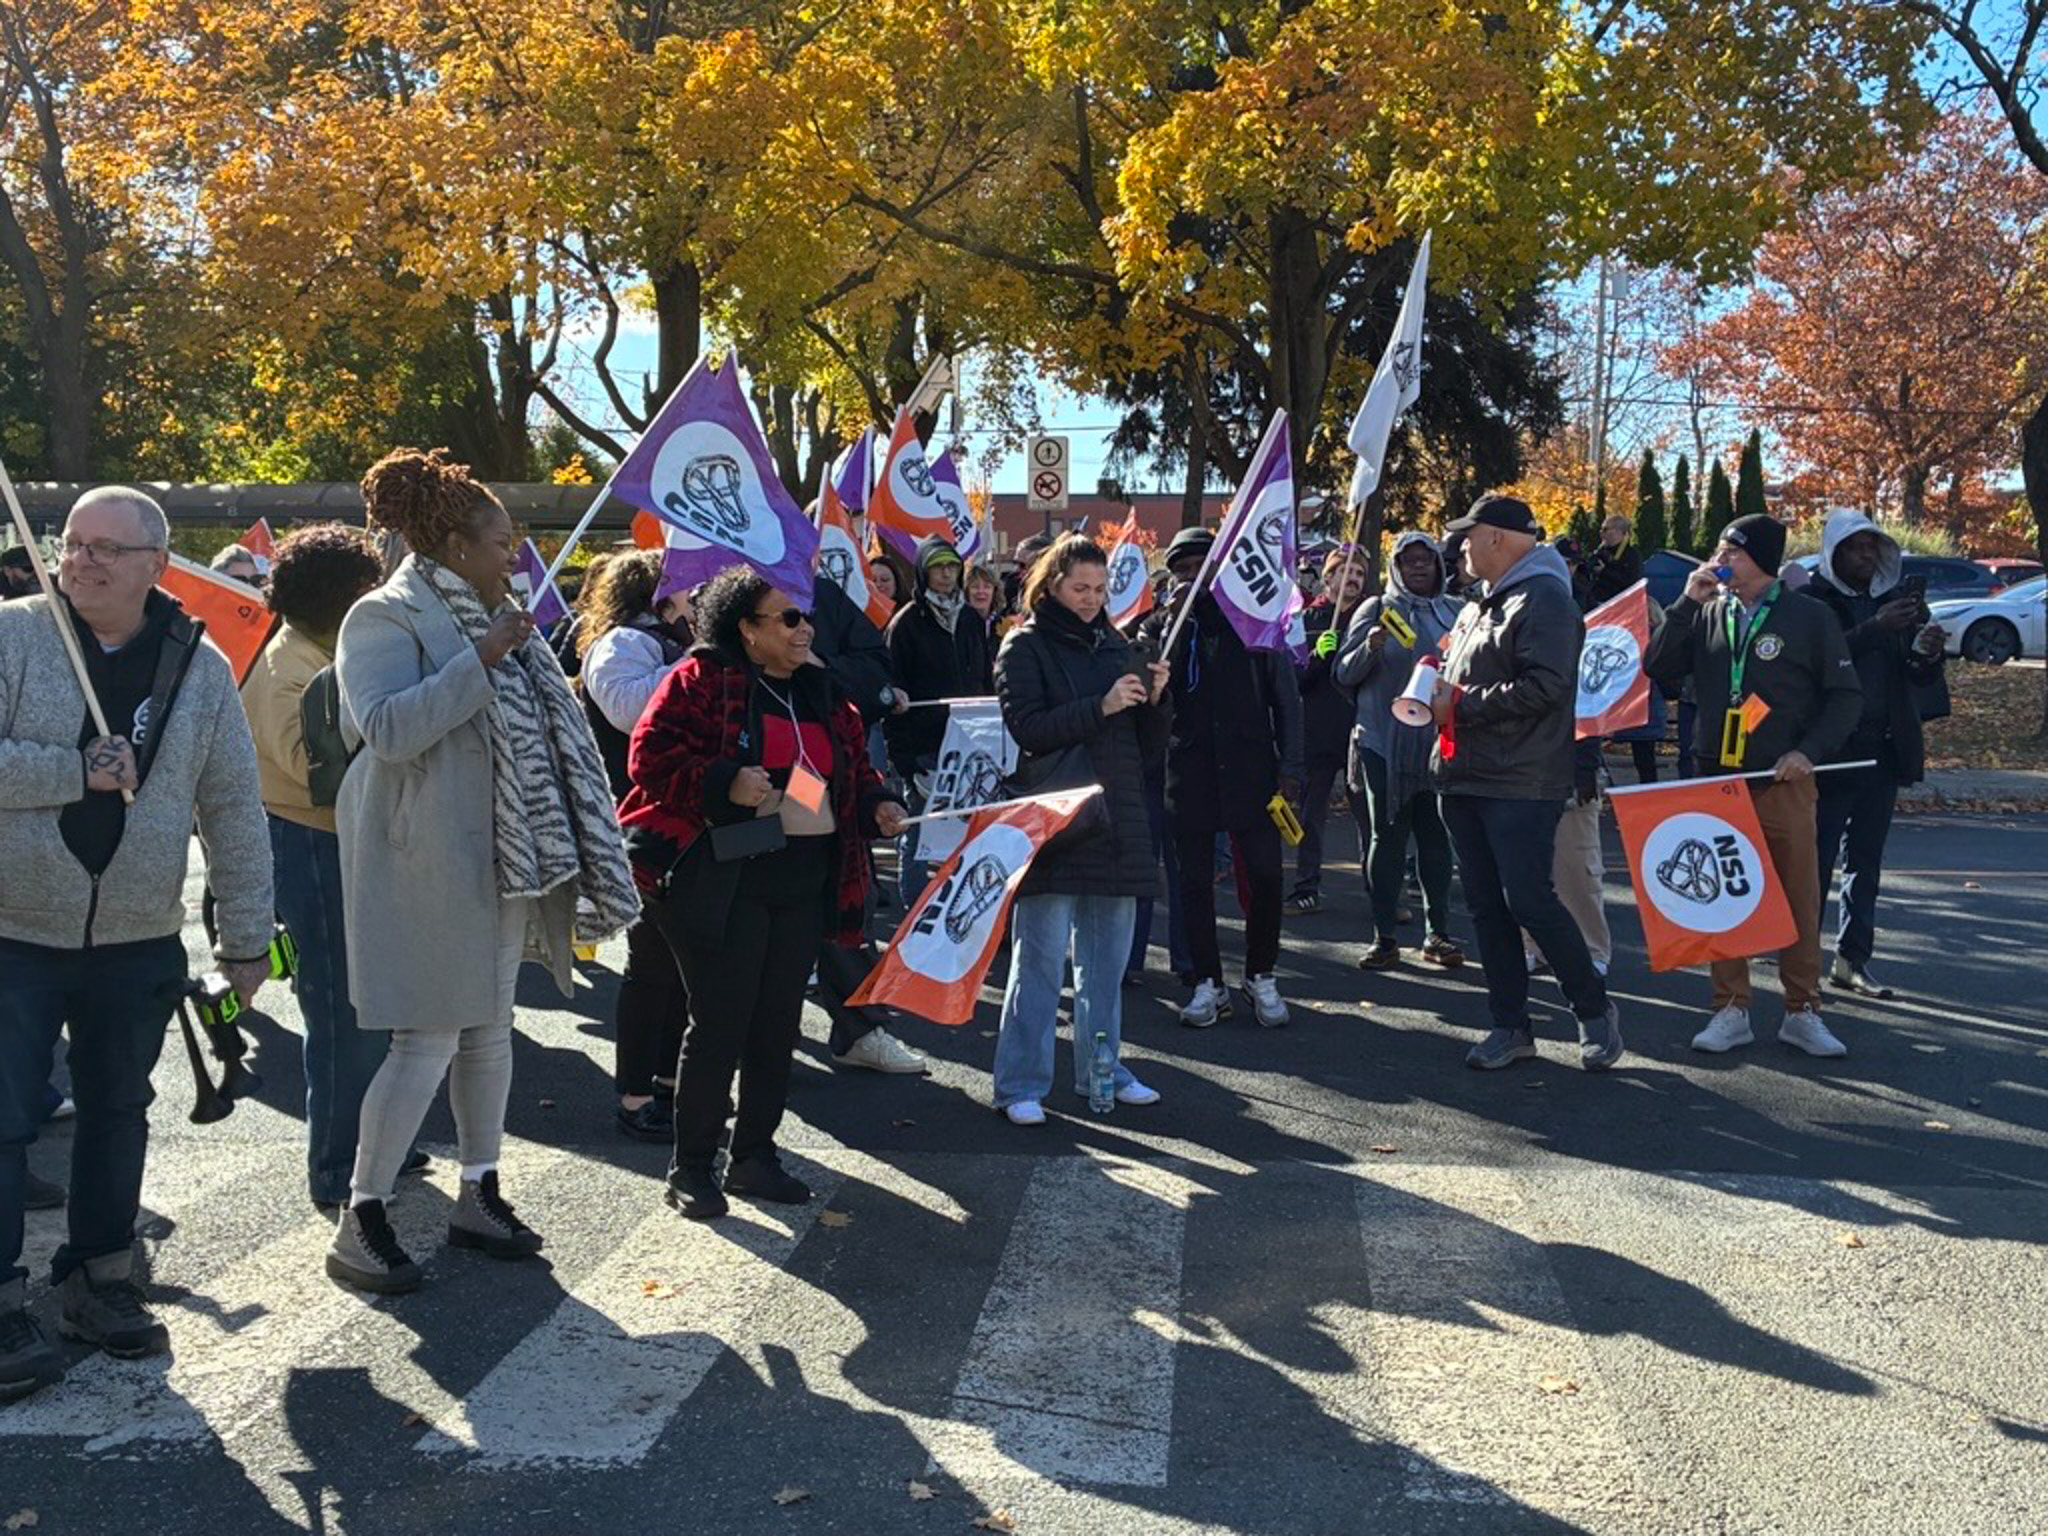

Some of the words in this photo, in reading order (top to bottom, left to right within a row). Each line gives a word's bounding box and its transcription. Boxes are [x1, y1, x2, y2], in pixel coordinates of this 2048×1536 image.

[952, 515, 972, 547] SN
[1230, 536, 1280, 607] CSN
[1713, 834, 1751, 897] CSN
